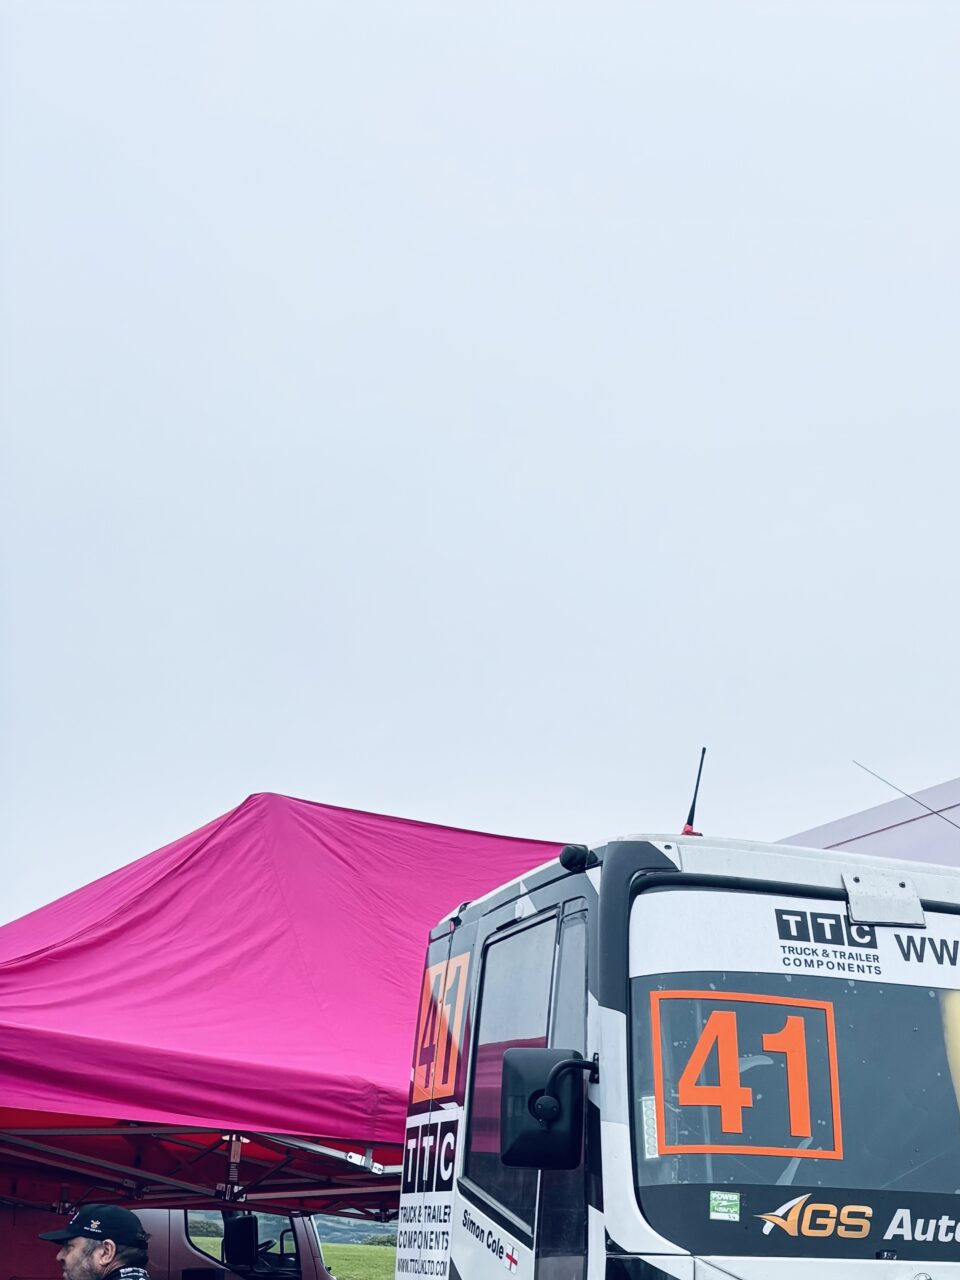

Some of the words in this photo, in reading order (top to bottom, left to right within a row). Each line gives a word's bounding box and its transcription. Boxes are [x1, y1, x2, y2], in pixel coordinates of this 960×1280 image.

[780, 913, 873, 945] TTC
[780, 945, 819, 958] TRUCK
[821, 949, 830, 958] &
[831, 950, 880, 964] TRAILER
[782, 957, 882, 975] COMPONENTS
[678, 1010, 812, 1138] 41
[406, 1130, 456, 1183] TTC
[400, 1205, 417, 1224] TRUCK
[423, 1204, 452, 1224] TRAILER
[753, 1193, 873, 1239] AGS
[398, 1230, 450, 1251] COMPONENTS
[462, 1209, 486, 1244] Simon
[486, 1230, 504, 1260] Cole
